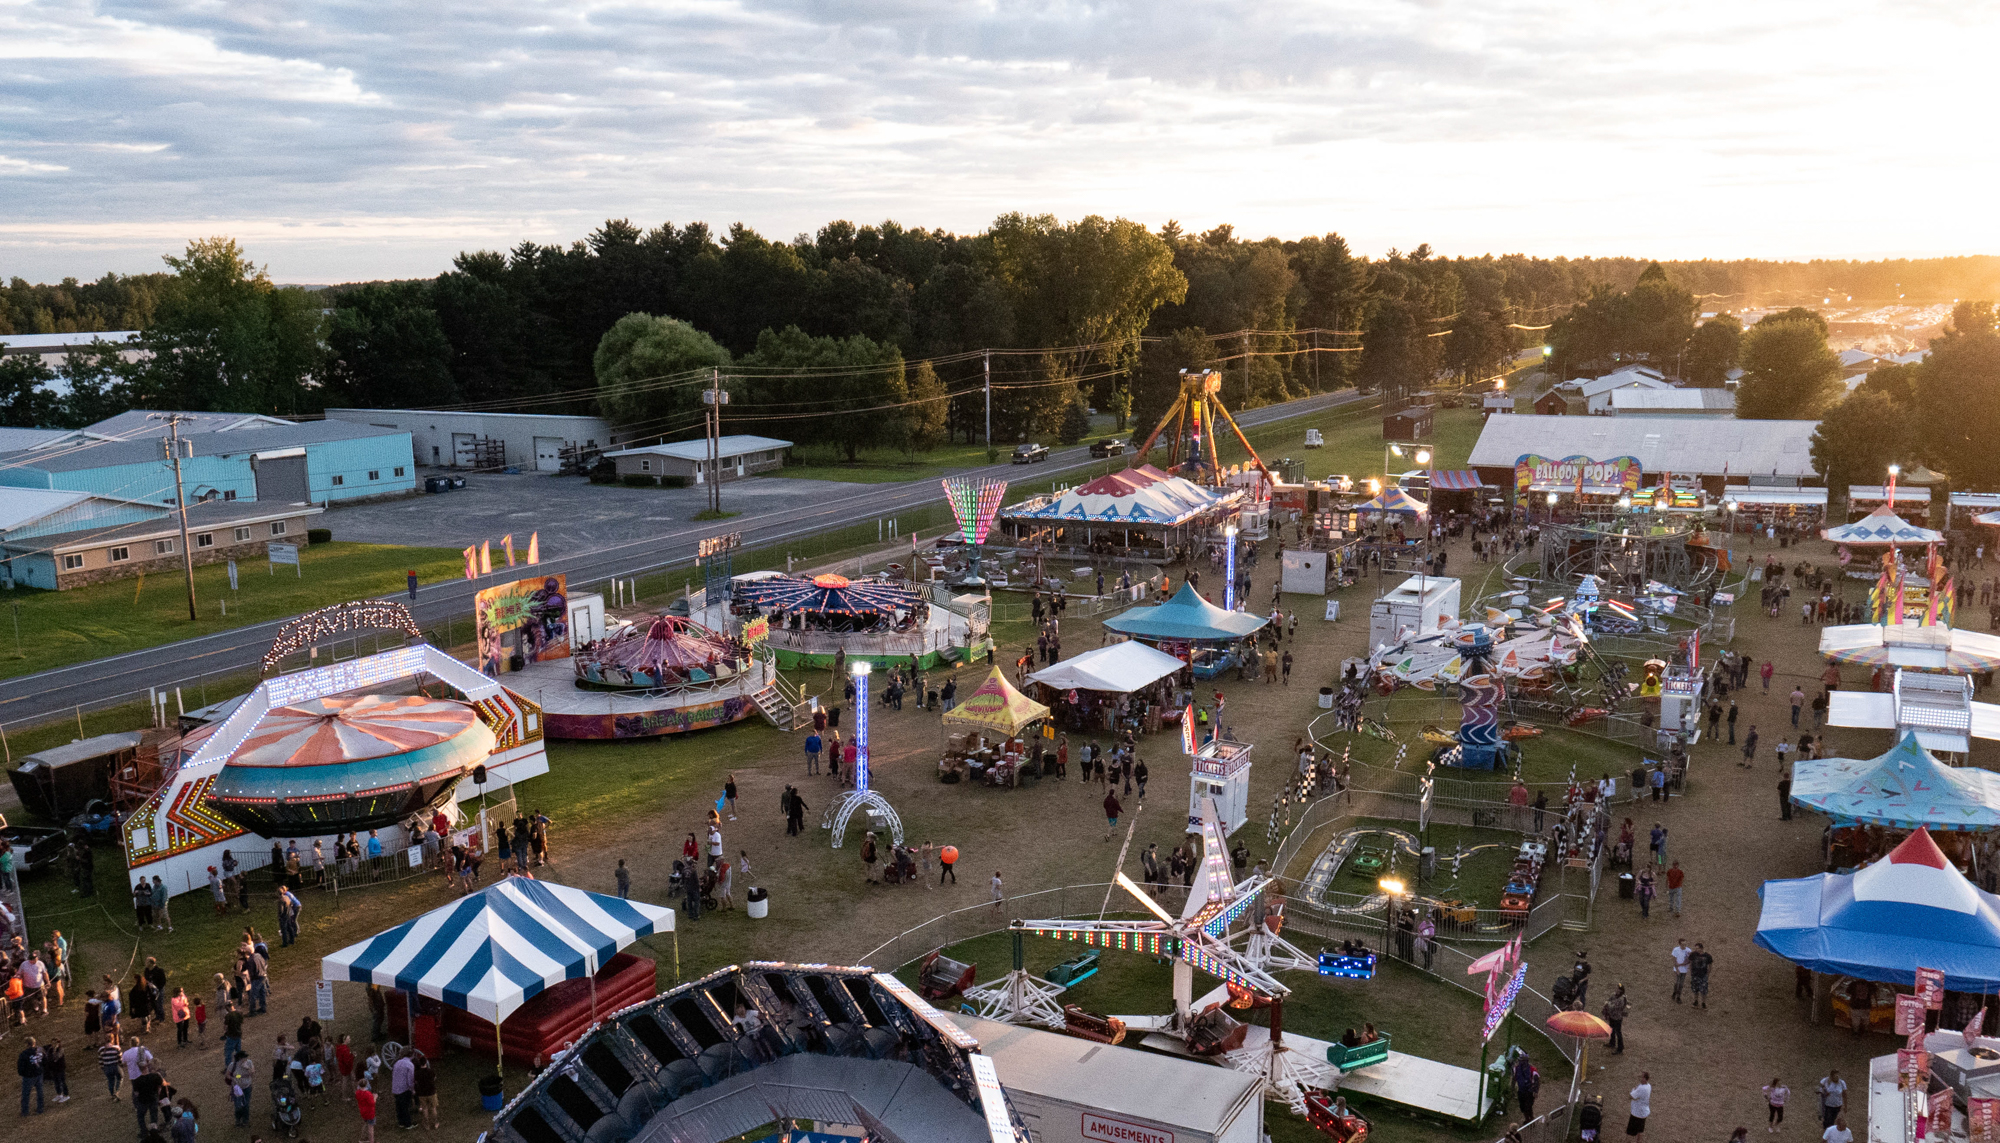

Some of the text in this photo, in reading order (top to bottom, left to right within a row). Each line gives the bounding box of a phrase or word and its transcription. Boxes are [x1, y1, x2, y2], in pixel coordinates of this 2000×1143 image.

[1535, 464, 1579, 480] BALLOON
[1584, 464, 1619, 481] POP!
[262, 600, 422, 676] GRAVITRON
[1667, 680, 1692, 691] TICKETS
[642, 706, 724, 728] BREAK DANCE
[1197, 760, 1224, 774] TICKETS
[1230, 754, 1247, 773] TICKETS
[1921, 971, 1940, 979] SNO
[1900, 1000, 1923, 1009] COTTON
[1090, 1122, 1165, 1143] AMUSEMENTS
